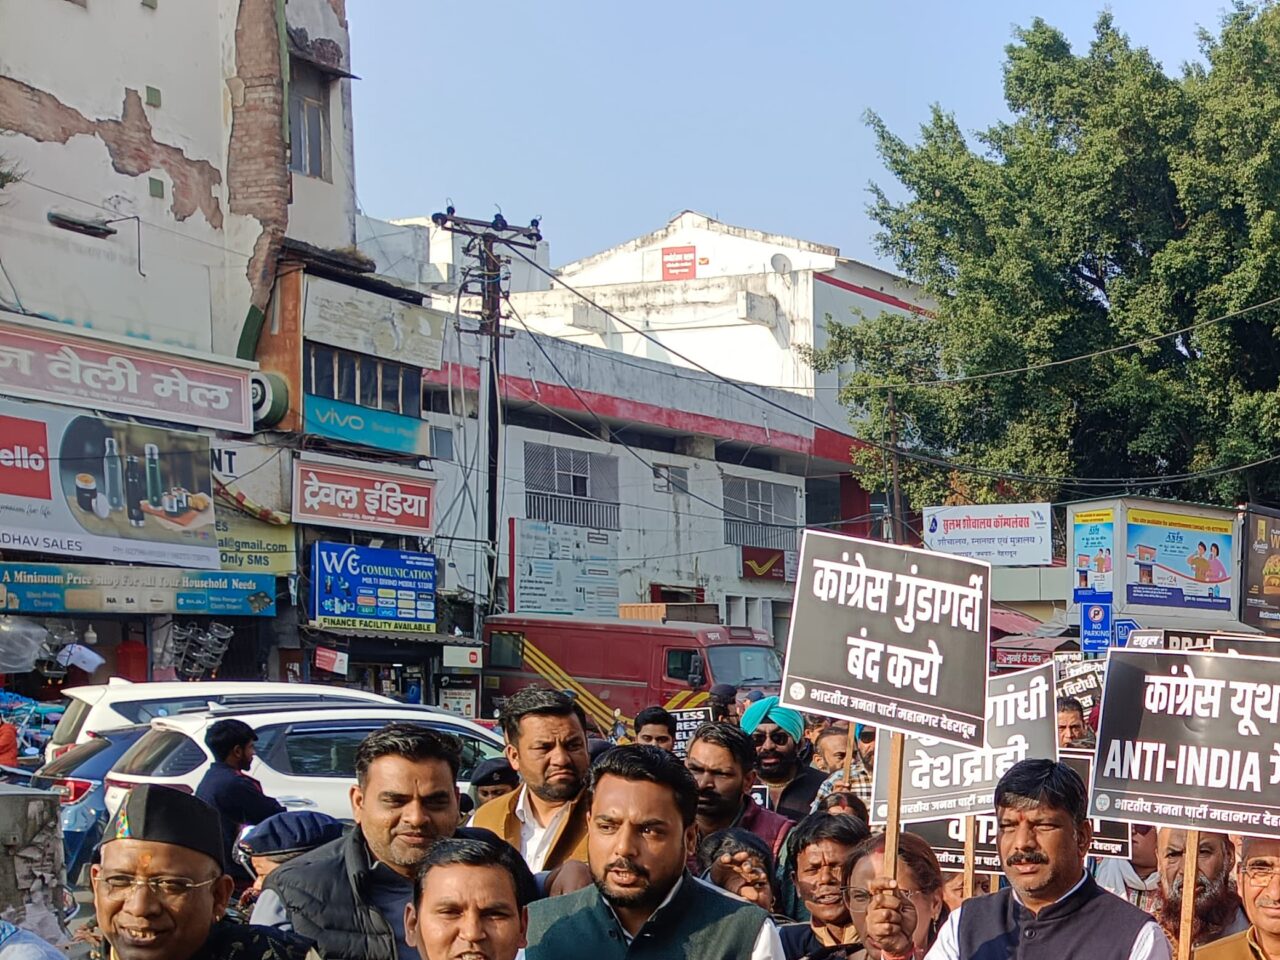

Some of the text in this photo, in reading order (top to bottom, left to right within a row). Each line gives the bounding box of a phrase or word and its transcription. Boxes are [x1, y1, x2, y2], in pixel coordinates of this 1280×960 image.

[152, 368, 233, 410] मेल
[315, 408, 365, 431] vivo
[0, 445, 45, 471] ello
[303, 472, 428, 518] ट्रेवल इंडिया
[963, 516, 992, 530] शौचालय
[0, 533, 83, 552] DHAV SALES
[217, 538, 288, 552] al@gmail.com
[220, 553, 243, 566] Only
[247, 554, 269, 566] SMS
[14, 571, 64, 585] Minimum
[182, 576, 228, 589] Household
[232, 578, 257, 590] Needs
[361, 564, 433, 581] COMMUNICATION
[812, 551, 985, 634] कांग्रेस गुंडागर्दी
[322, 617, 432, 631] FINANCE FACILITY AVAILABLE
[1092, 623, 1102, 631] NO
[847, 627, 942, 696] बंद करो
[1144, 664, 1226, 719] कांग्रेस
[810, 686, 978, 738] भारतीय जनता पार्टी महानगर देहरादून
[1102, 738, 1263, 794] ANTI-INDIA
[900, 801, 929, 814] ारतीय
[931, 799, 957, 812] जनता
[1114, 797, 1151, 813] भारतीय
[1153, 803, 1183, 818] जनता
[1184, 803, 1209, 820] पार्टी
[1209, 809, 1260, 825] महानगर
